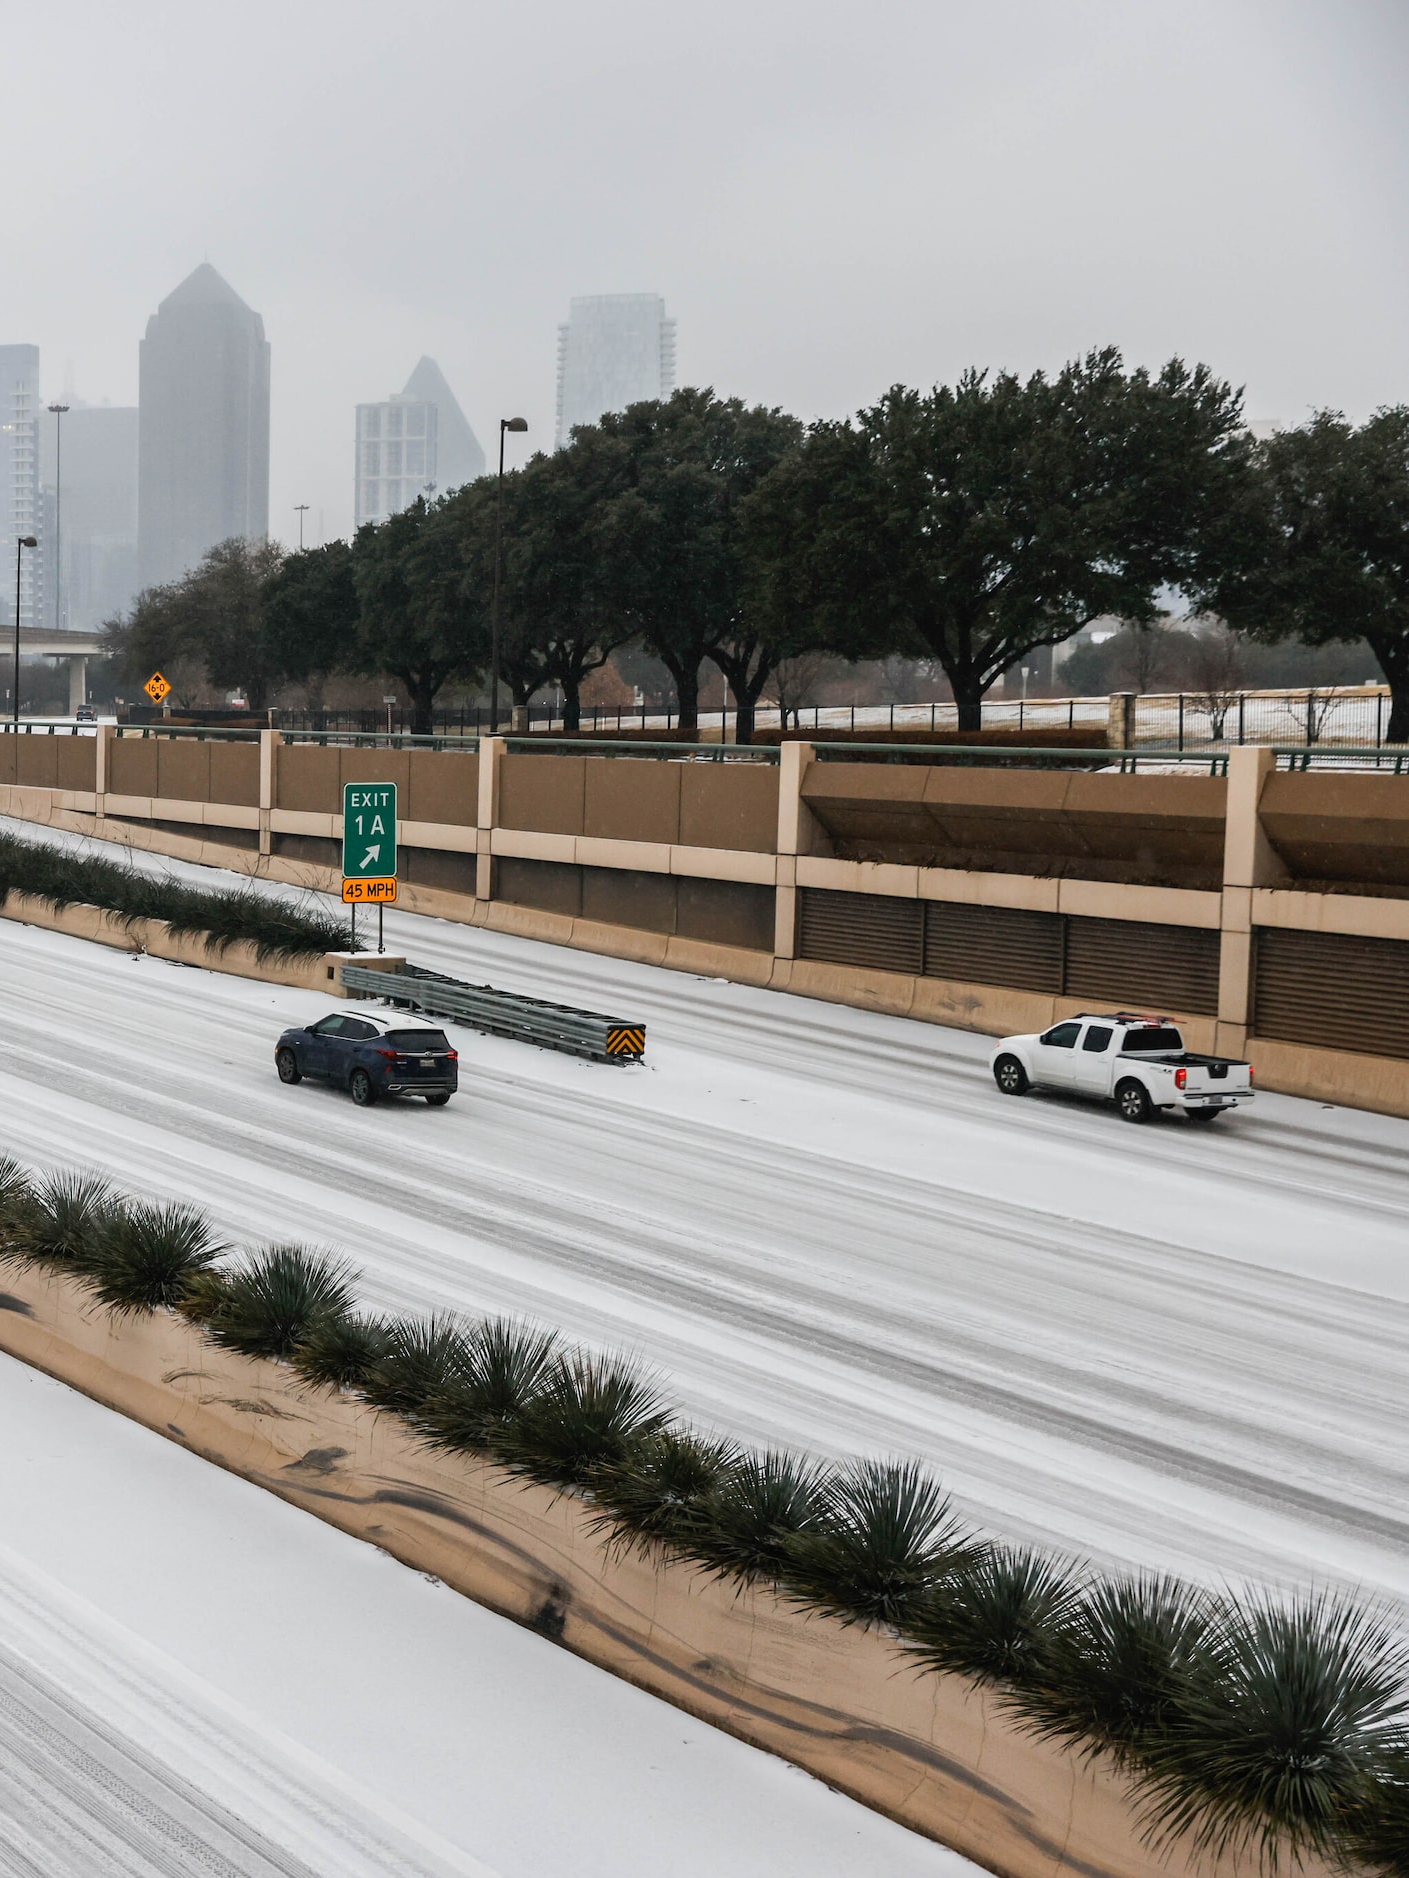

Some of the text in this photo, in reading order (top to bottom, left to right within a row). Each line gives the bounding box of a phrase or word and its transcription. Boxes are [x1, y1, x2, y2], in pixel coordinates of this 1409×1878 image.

[351, 793, 389, 807] EXIT
[355, 815, 385, 836] 1A
[345, 883, 394, 898] 45 MPH
